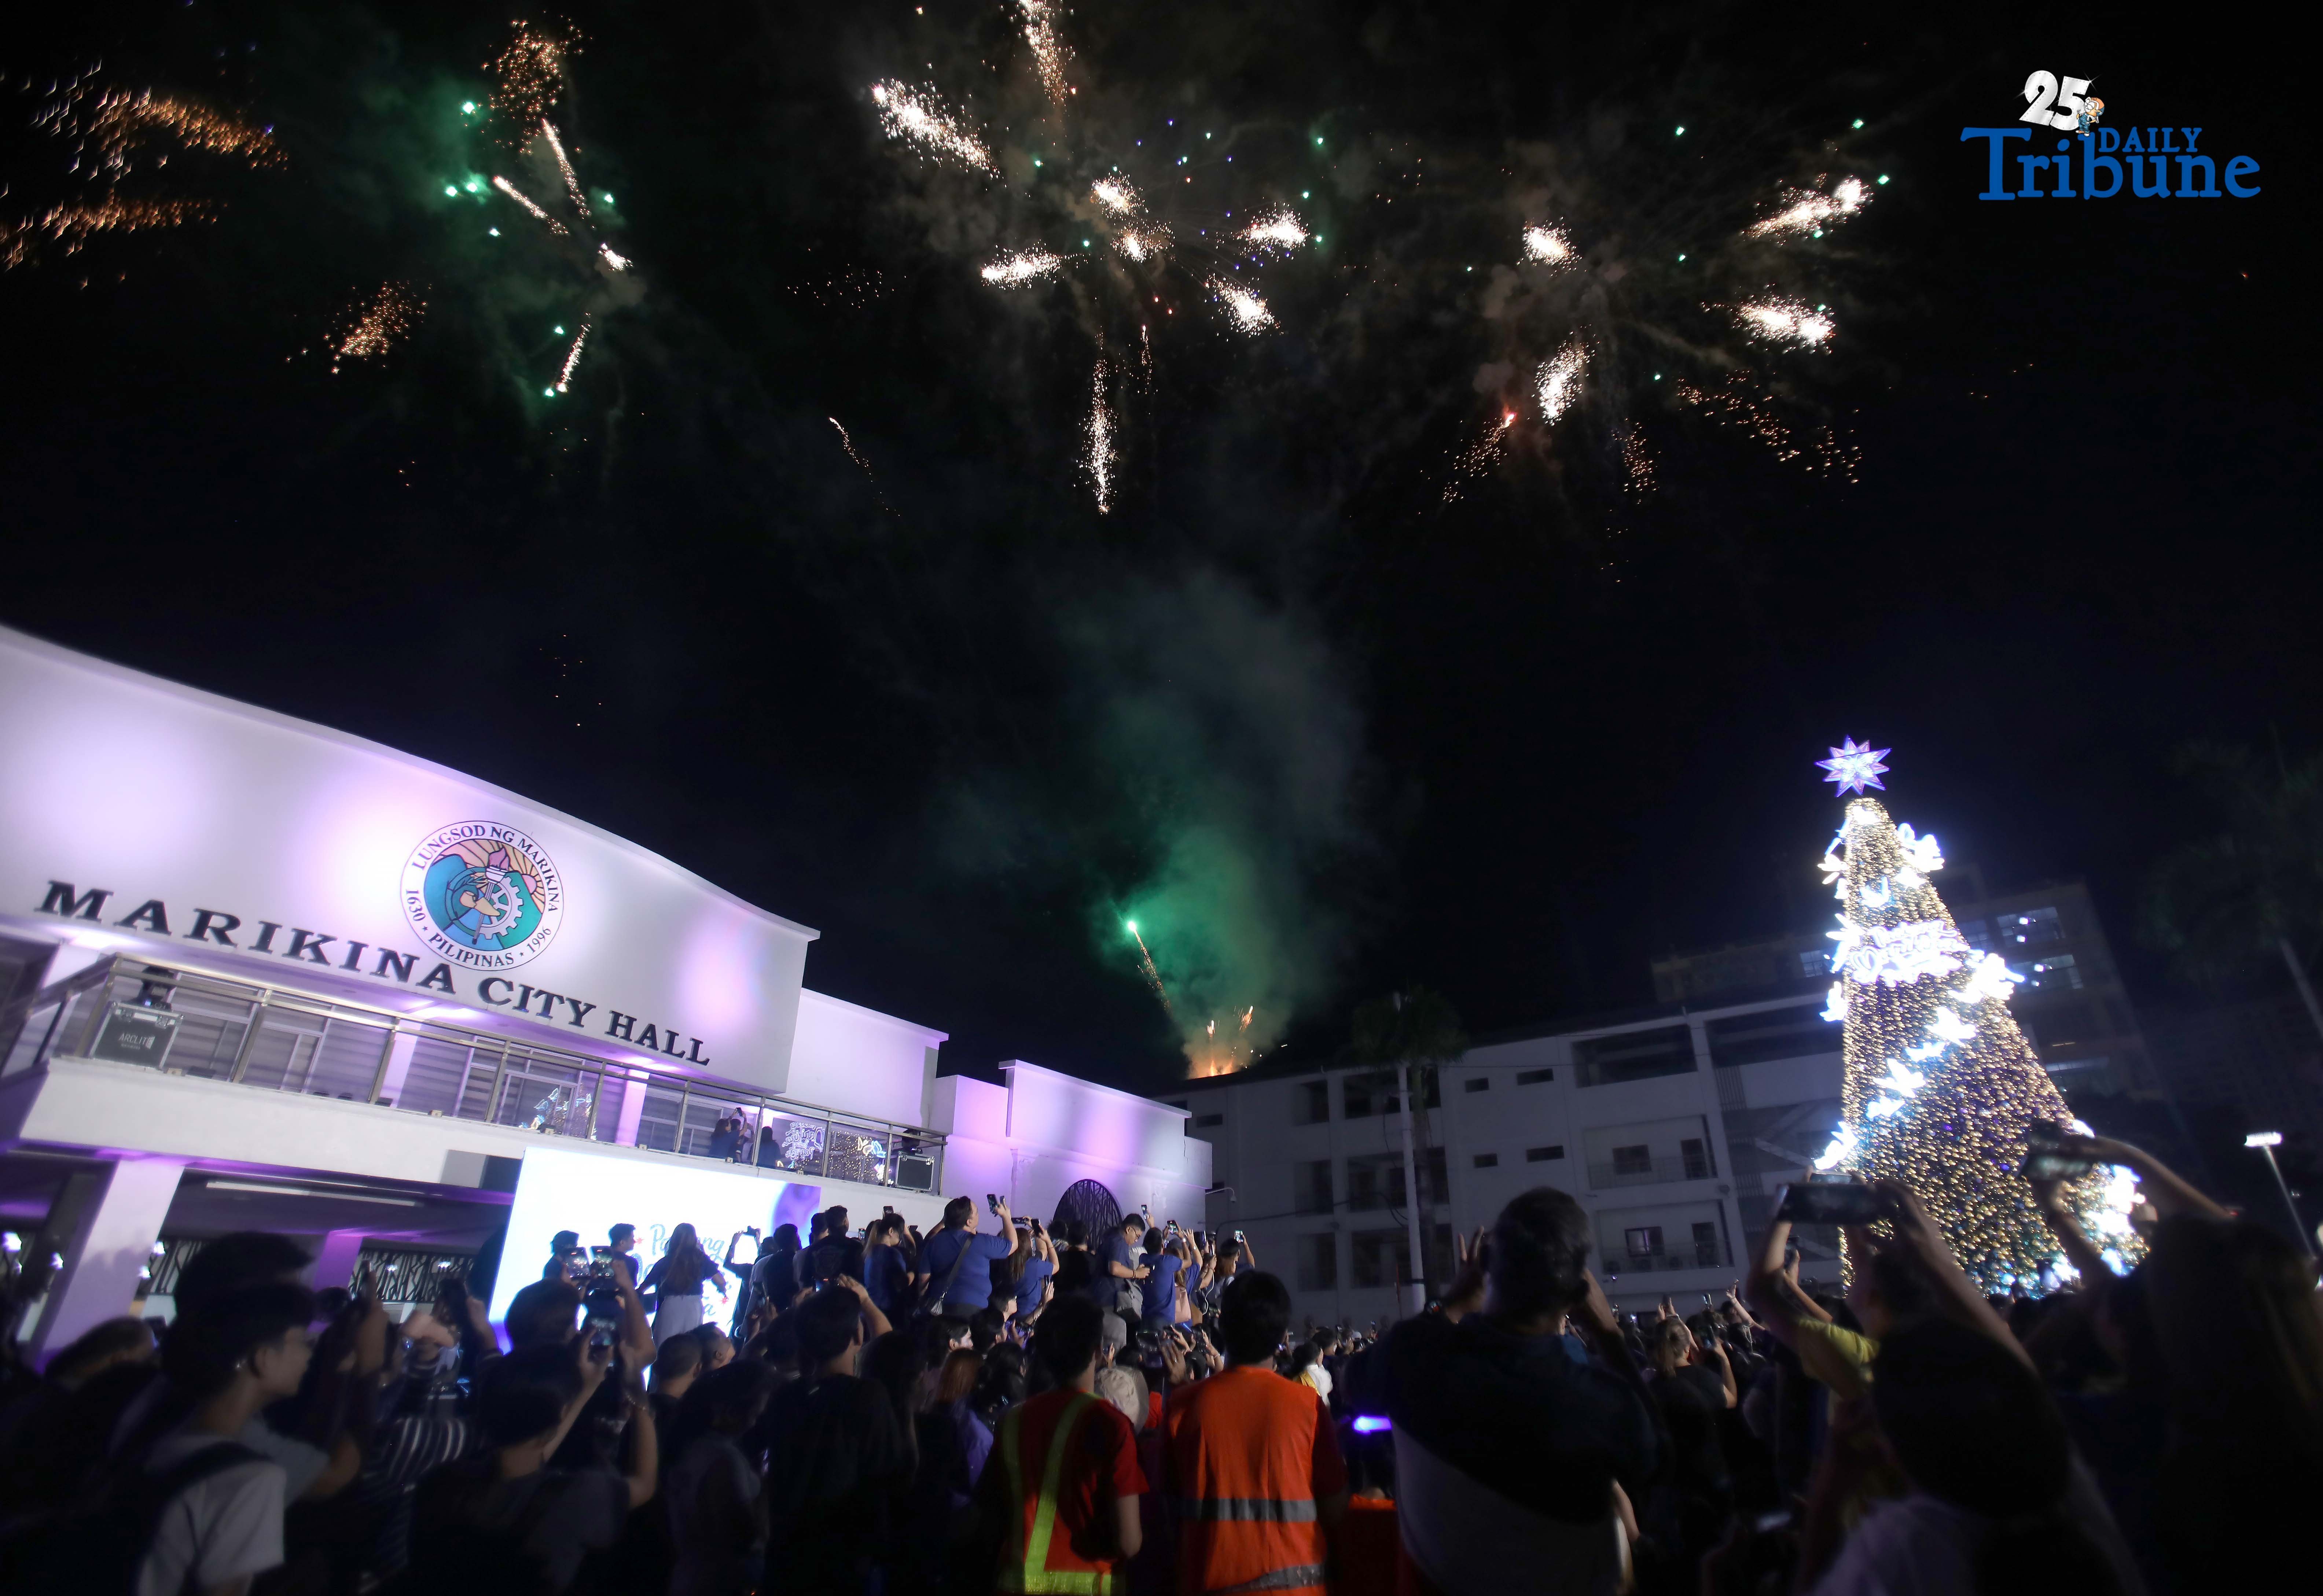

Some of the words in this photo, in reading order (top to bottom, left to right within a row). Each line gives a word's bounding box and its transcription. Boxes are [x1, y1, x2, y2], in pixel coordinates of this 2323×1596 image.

[412, 825, 485, 871] LUNGSOD
[490, 826, 515, 843] NG
[517, 838, 560, 912] MARIKINA
[406, 889, 426, 922] 1630
[429, 932, 514, 967] PILIPINAS
[526, 926, 552, 953] 1996
[34, 880, 457, 994] MARIKINA
[478, 977, 597, 1028] CITY
[604, 1010, 710, 1066] HALL
